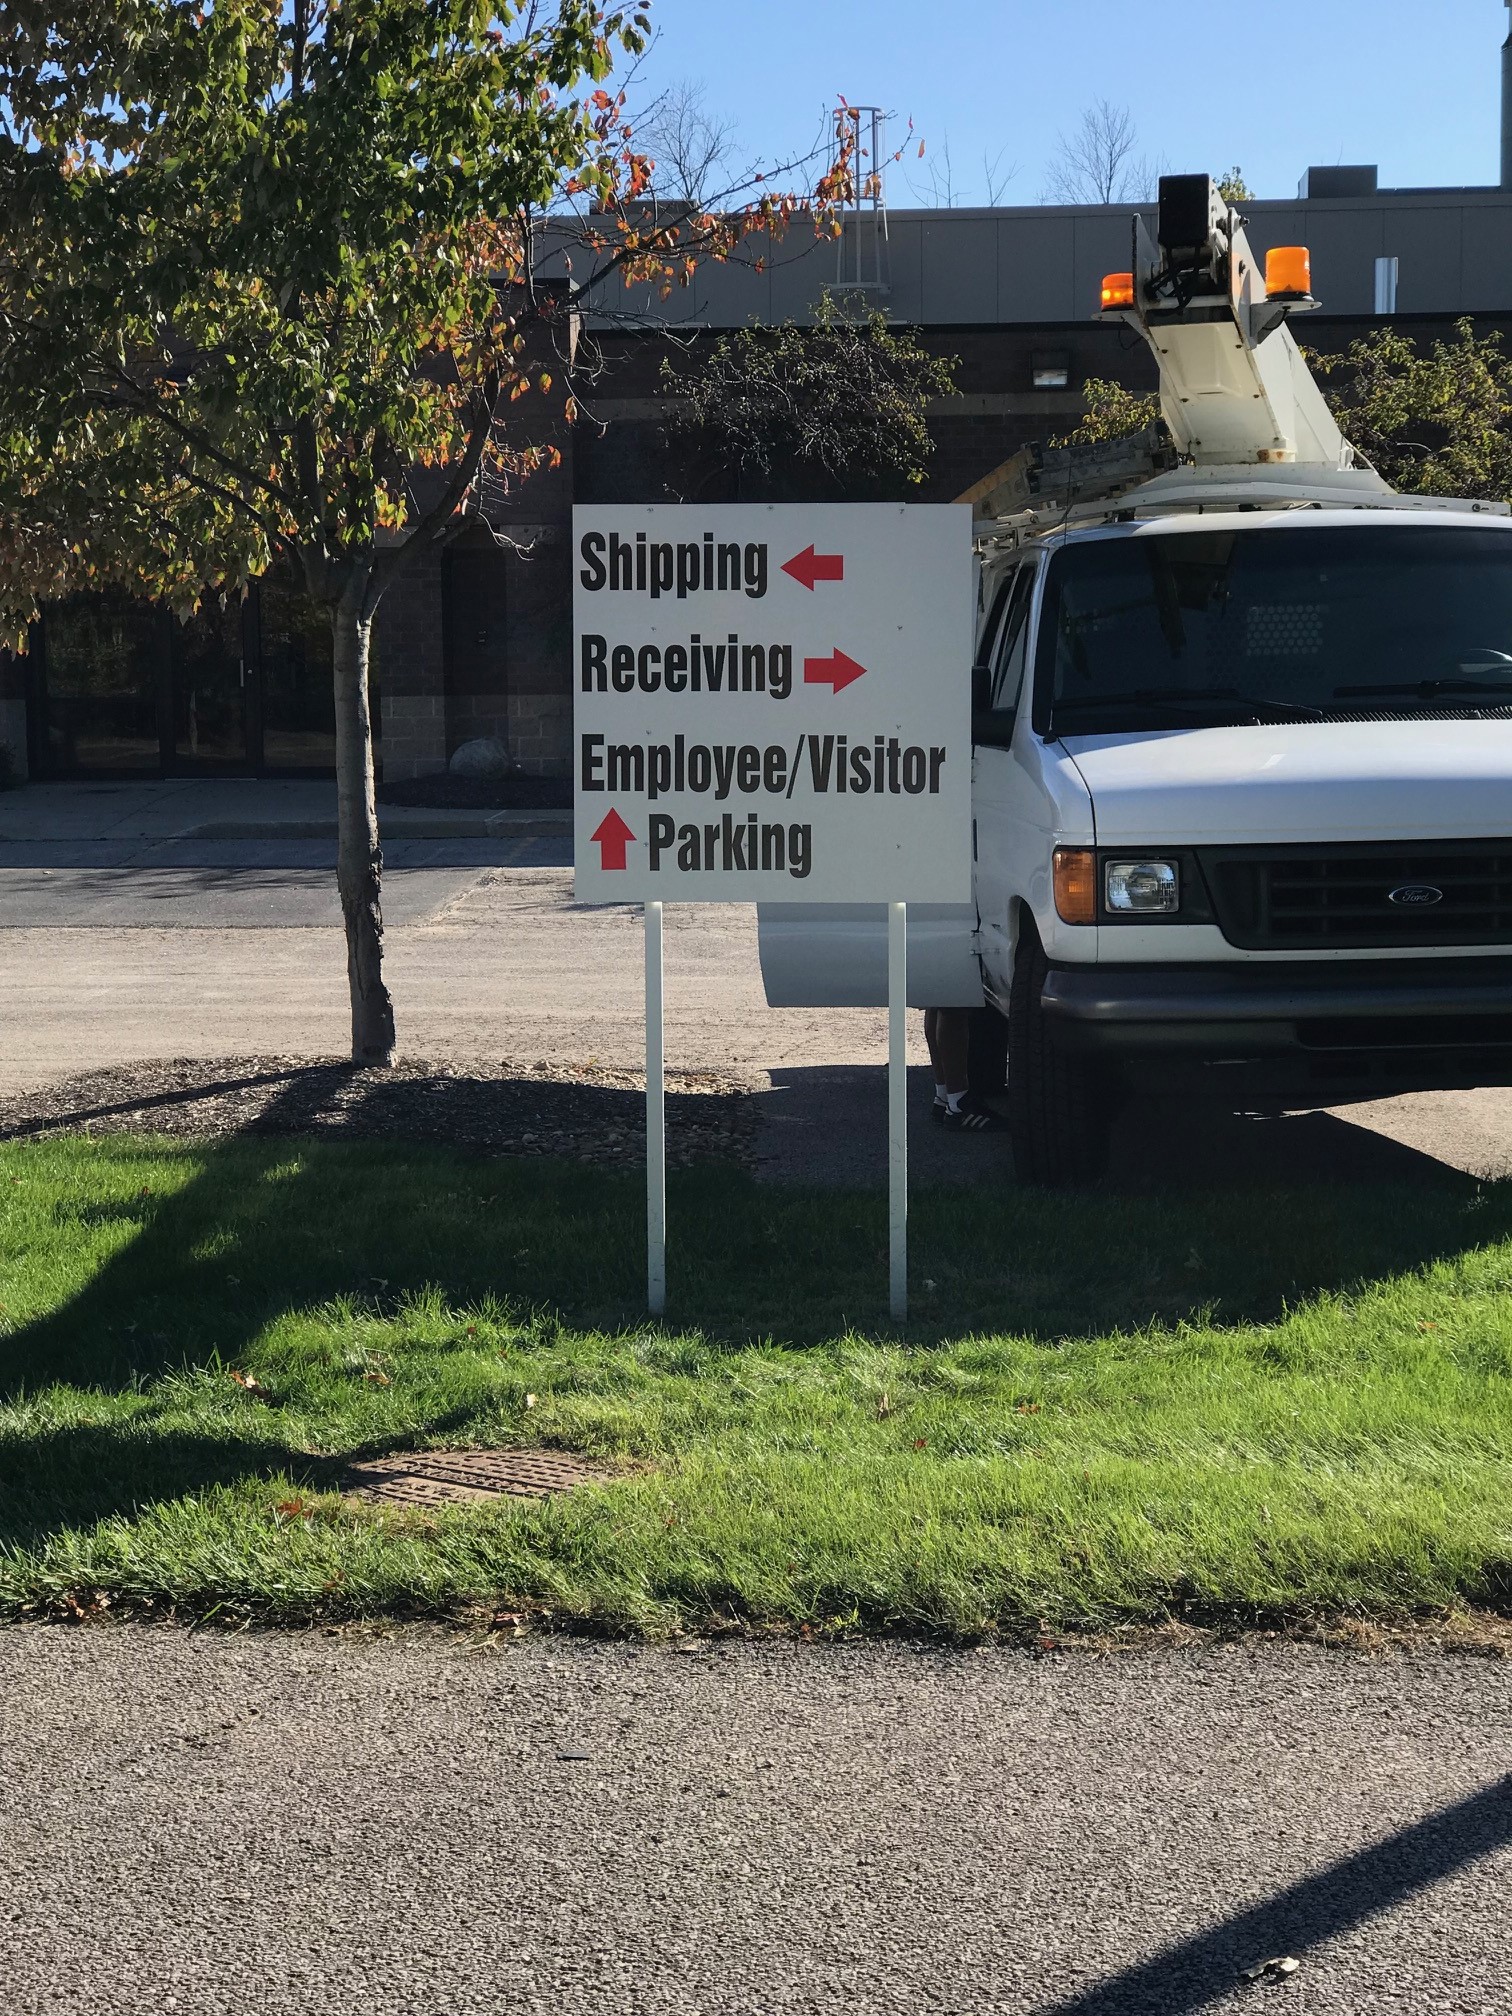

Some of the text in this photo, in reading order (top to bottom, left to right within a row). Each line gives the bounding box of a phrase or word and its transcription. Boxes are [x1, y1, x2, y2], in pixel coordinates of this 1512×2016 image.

[580, 531, 768, 599] Shipping
[581, 633, 793, 700] Receiving
[581, 733, 946, 800] Employee/Visitor
[648, 812, 812, 879] Parking
[1402, 890, 1430, 902] Ford
